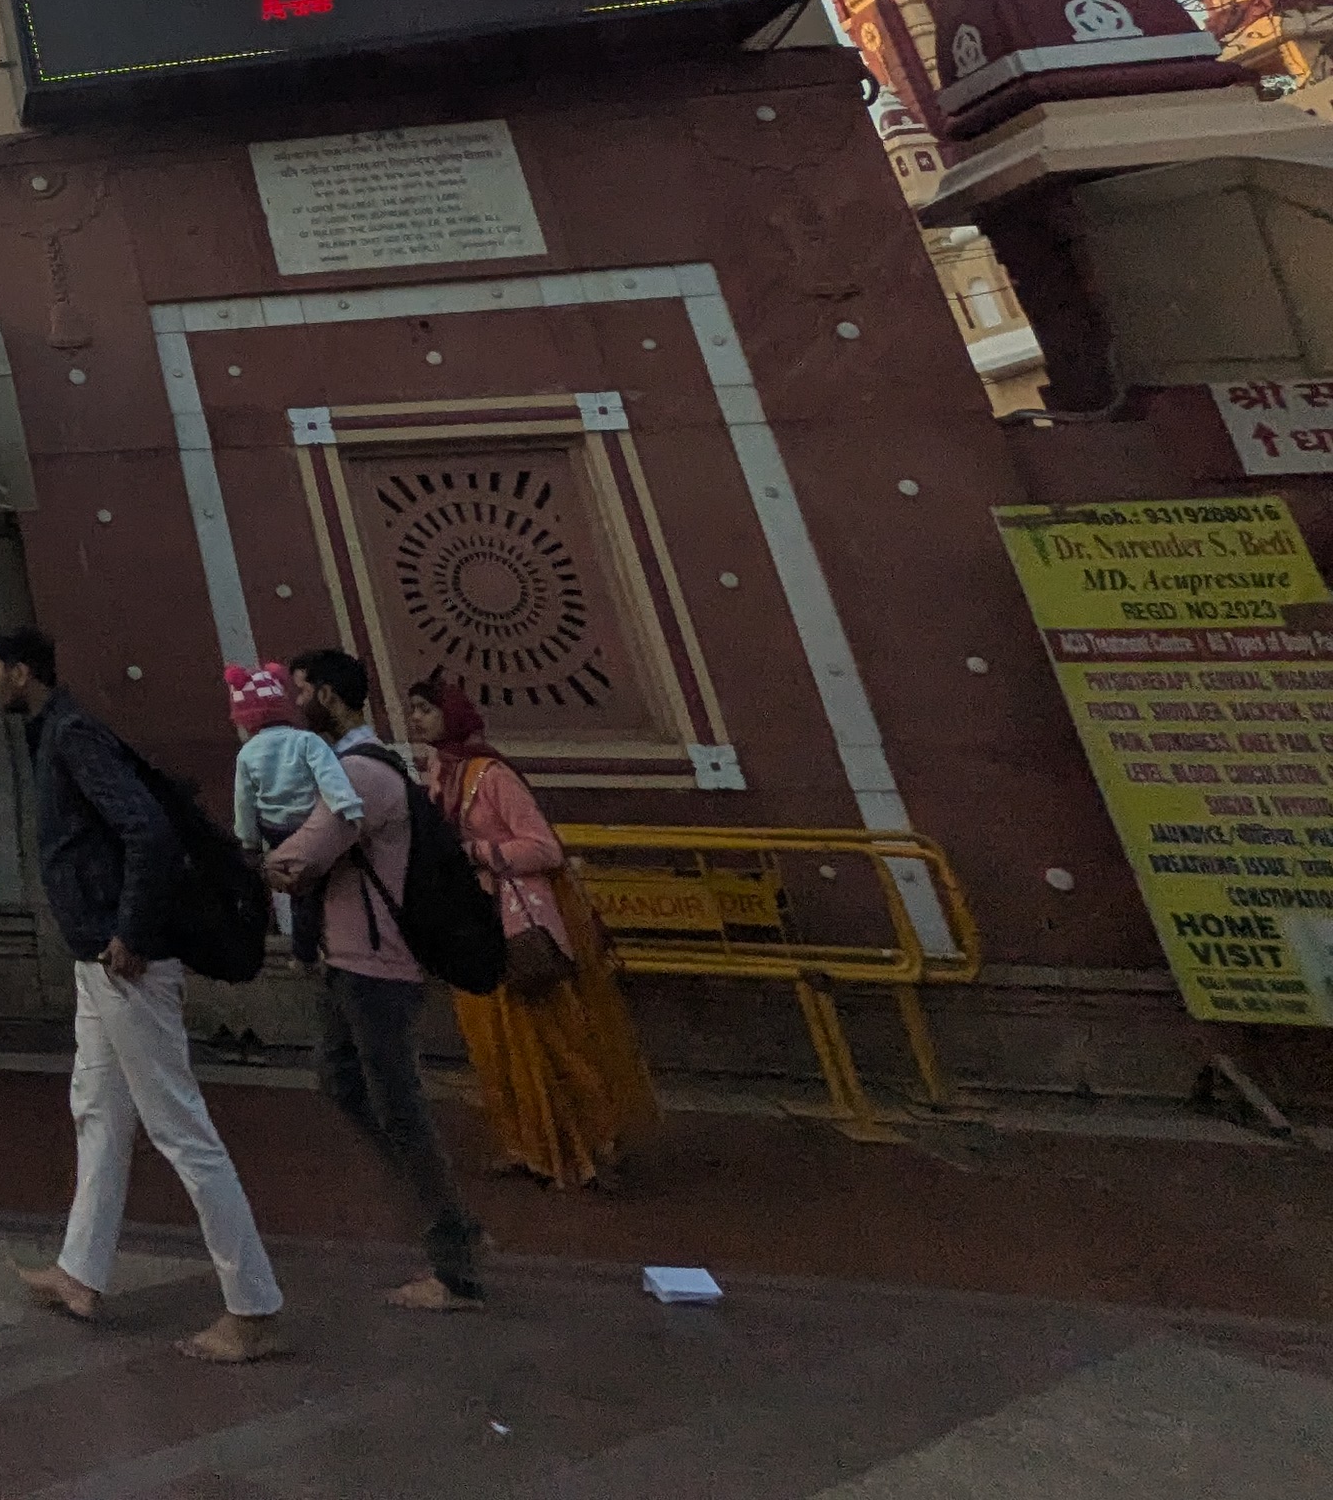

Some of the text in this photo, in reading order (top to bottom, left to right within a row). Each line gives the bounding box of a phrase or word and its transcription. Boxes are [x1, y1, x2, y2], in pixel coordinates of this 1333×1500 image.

[1142, 569, 1293, 597] Acupressure
[1170, 912, 1281, 940] HOME
[1187, 941, 1282, 968] VISIT
